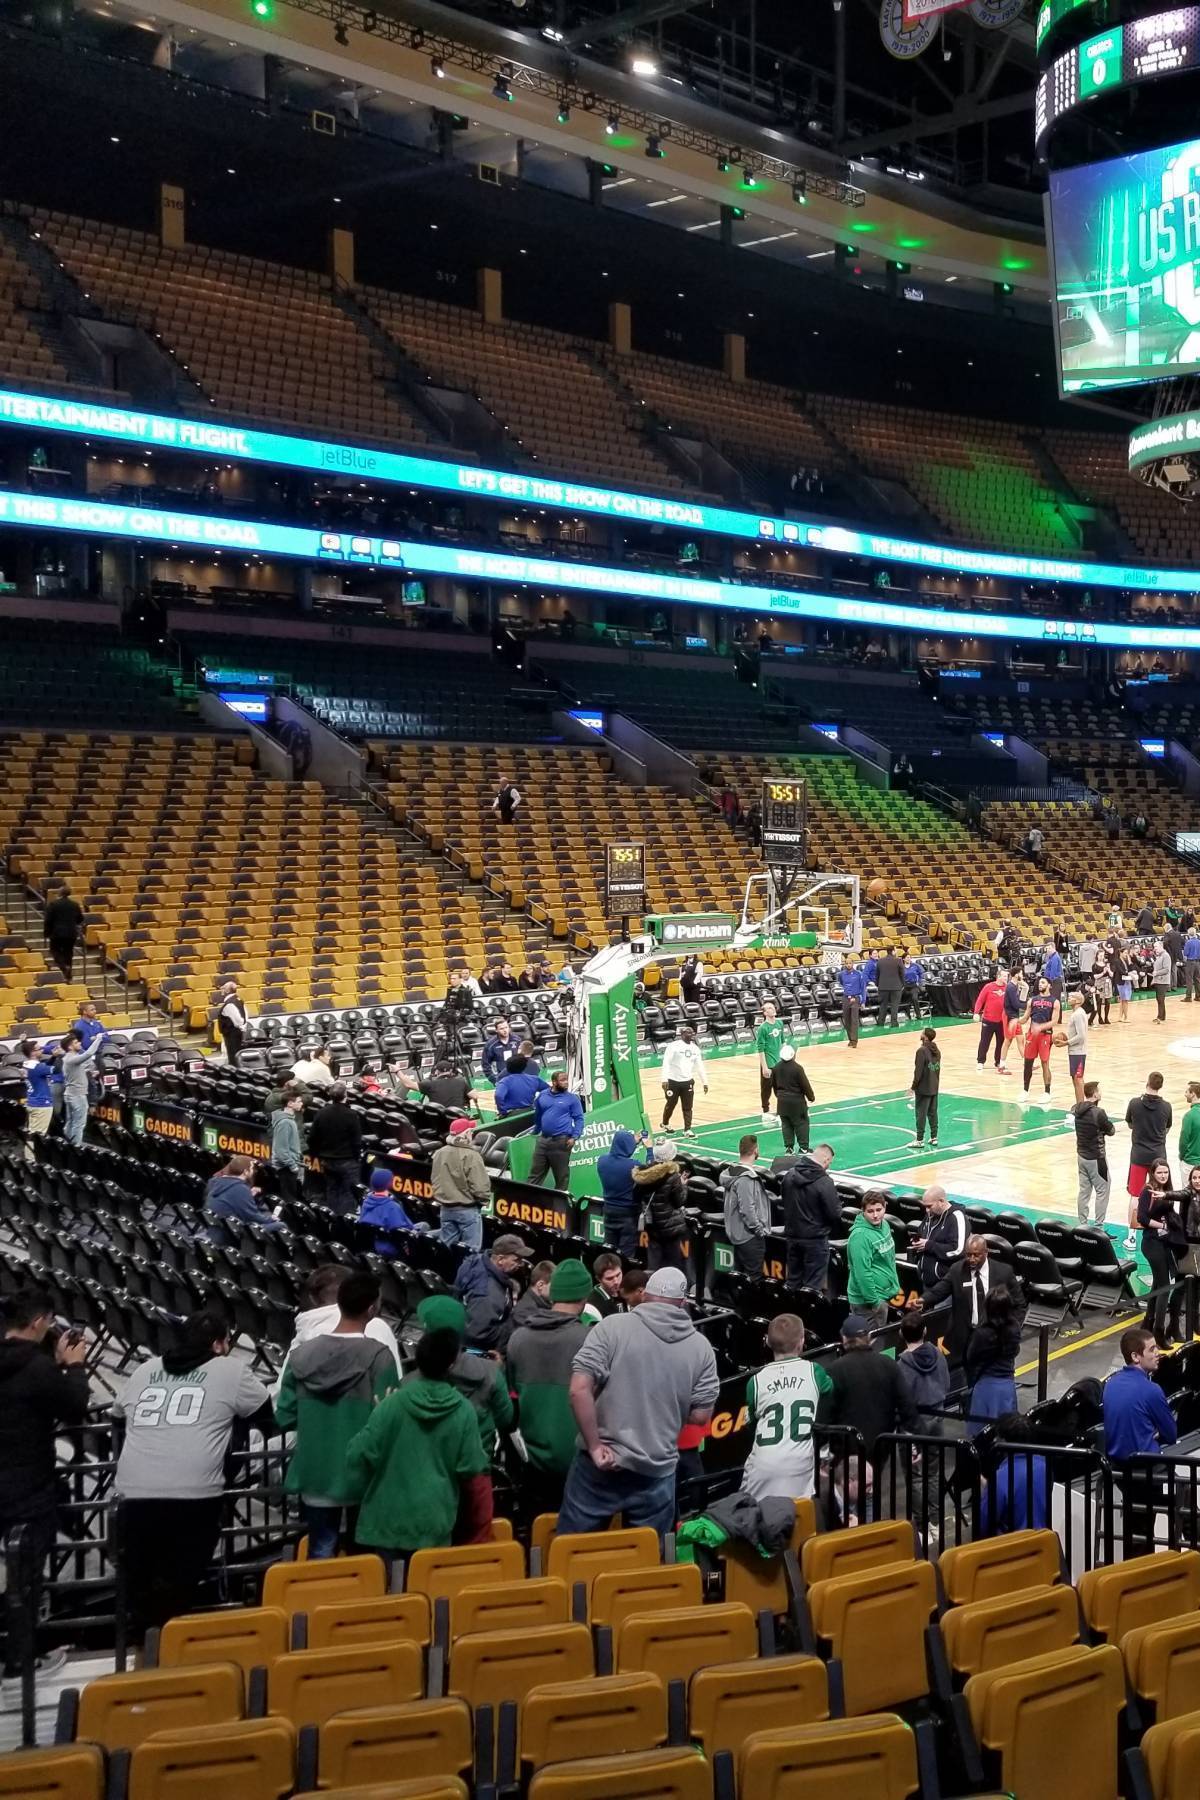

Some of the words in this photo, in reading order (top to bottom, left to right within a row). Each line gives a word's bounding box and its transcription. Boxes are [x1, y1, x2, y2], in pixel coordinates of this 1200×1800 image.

[1093, 59, 1106, 84] 0
[1138, 201, 1177, 272] US
[437, 271, 457, 284] 317
[153, 420, 176, 442] IN
[180, 424, 248, 453] FLIGHT.
[320, 446, 376, 470] jetBlue
[459, 466, 496, 490] LET'S
[499, 474, 529, 496] GET
[531, 481, 563, 502] THIS
[566, 486, 611, 508] SHOW
[612, 494, 637, 513] ON
[638, 499, 663, 518] THE
[665, 504, 704, 525] ROAD.
[1123, 570, 1158, 585] jetBlue
[770, 594, 800, 609] jetBlue
[774, 833, 801, 843] TISSOT
[622, 883, 643, 891] TISSOT
[677, 924, 732, 940] Putnam
[762, 937, 791, 949] xfinity
[612, 1003, 629, 1061] xfinity
[146, 1118, 191, 1140] GARDEN
[580, 1119, 616, 1137] oston
[205, 1131, 217, 1146] TD
[219, 1136, 271, 1160] GARDEN
[392, 1176, 433, 1199] GARD
[496, 1199, 567, 1230] GARDEN
[767, 1376, 805, 1395] SMART
[133, 1386, 206, 1427] 20
[756, 1400, 815, 1447] 36
